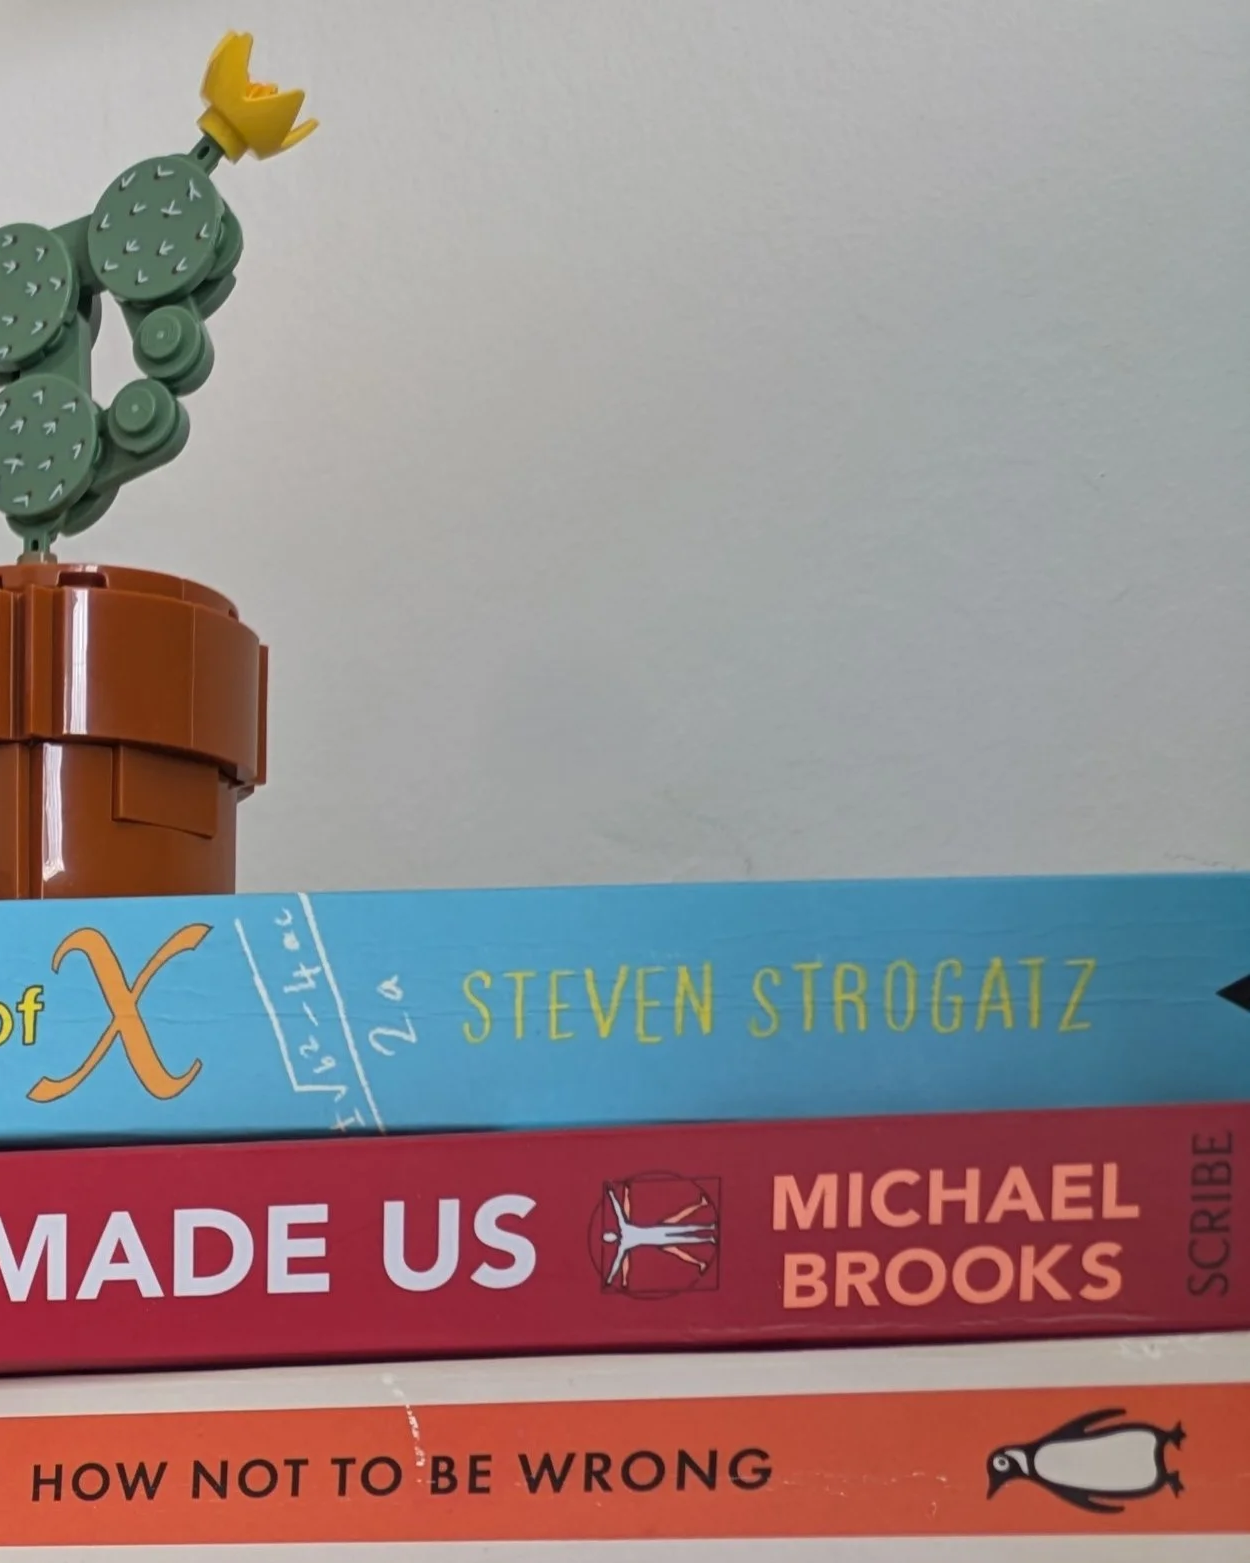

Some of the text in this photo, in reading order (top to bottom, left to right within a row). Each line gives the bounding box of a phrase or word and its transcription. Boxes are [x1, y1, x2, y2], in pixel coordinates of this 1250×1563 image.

[462, 957, 1097, 1044] STEVEN STROGATZ
[772, 1162, 1140, 1231] MICHAEL
[1187, 1130, 1234, 1298] SCRIBE
[383, 1194, 537, 1292] US
[783, 1242, 1123, 1309] BROOKS
[31, 1461, 168, 1502] HOW
[191, 1458, 309, 1499] NOT
[330, 1455, 403, 1497] TO
[429, 1454, 492, 1495] BE
[517, 1447, 774, 1494] WRONG
